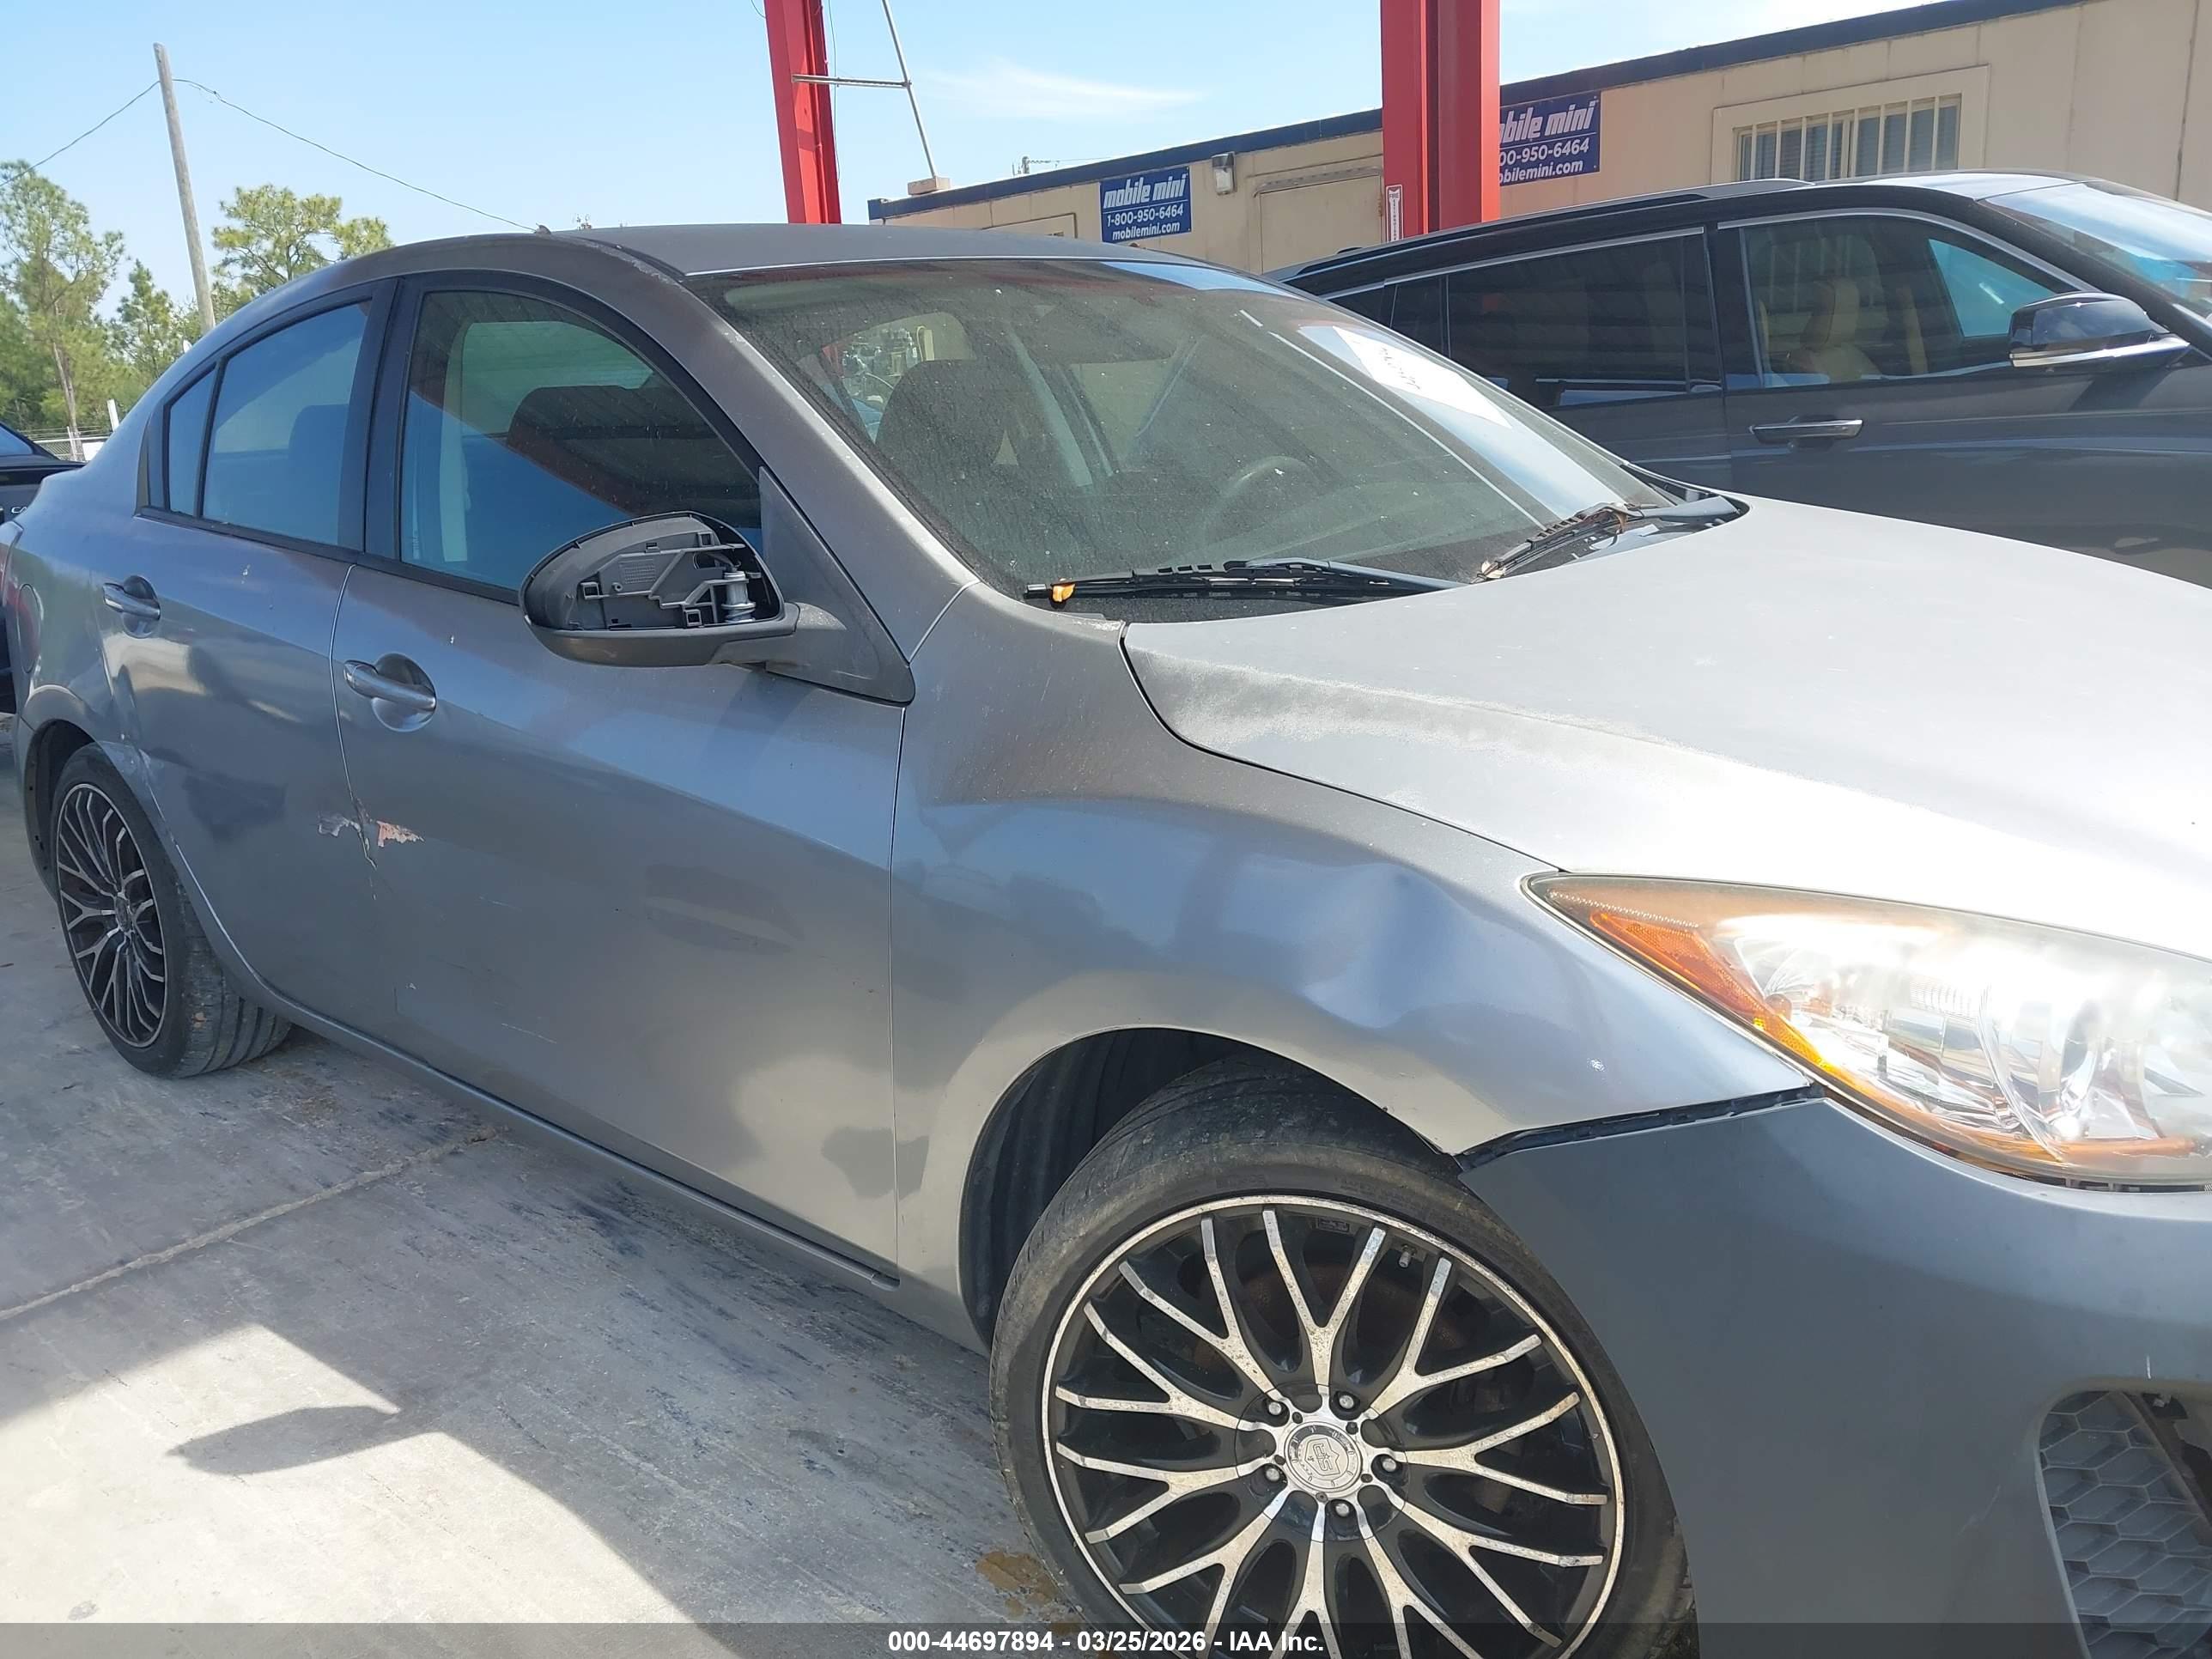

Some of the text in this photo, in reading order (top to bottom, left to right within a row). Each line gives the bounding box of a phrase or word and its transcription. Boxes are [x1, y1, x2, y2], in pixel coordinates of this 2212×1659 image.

[1544, 100, 1595, 137] mini
[1103, 173, 1187, 210] mobile mini
[1107, 203, 1184, 228] 1-800-950-6464
[1112, 222, 1181, 241] mobilemini.com
